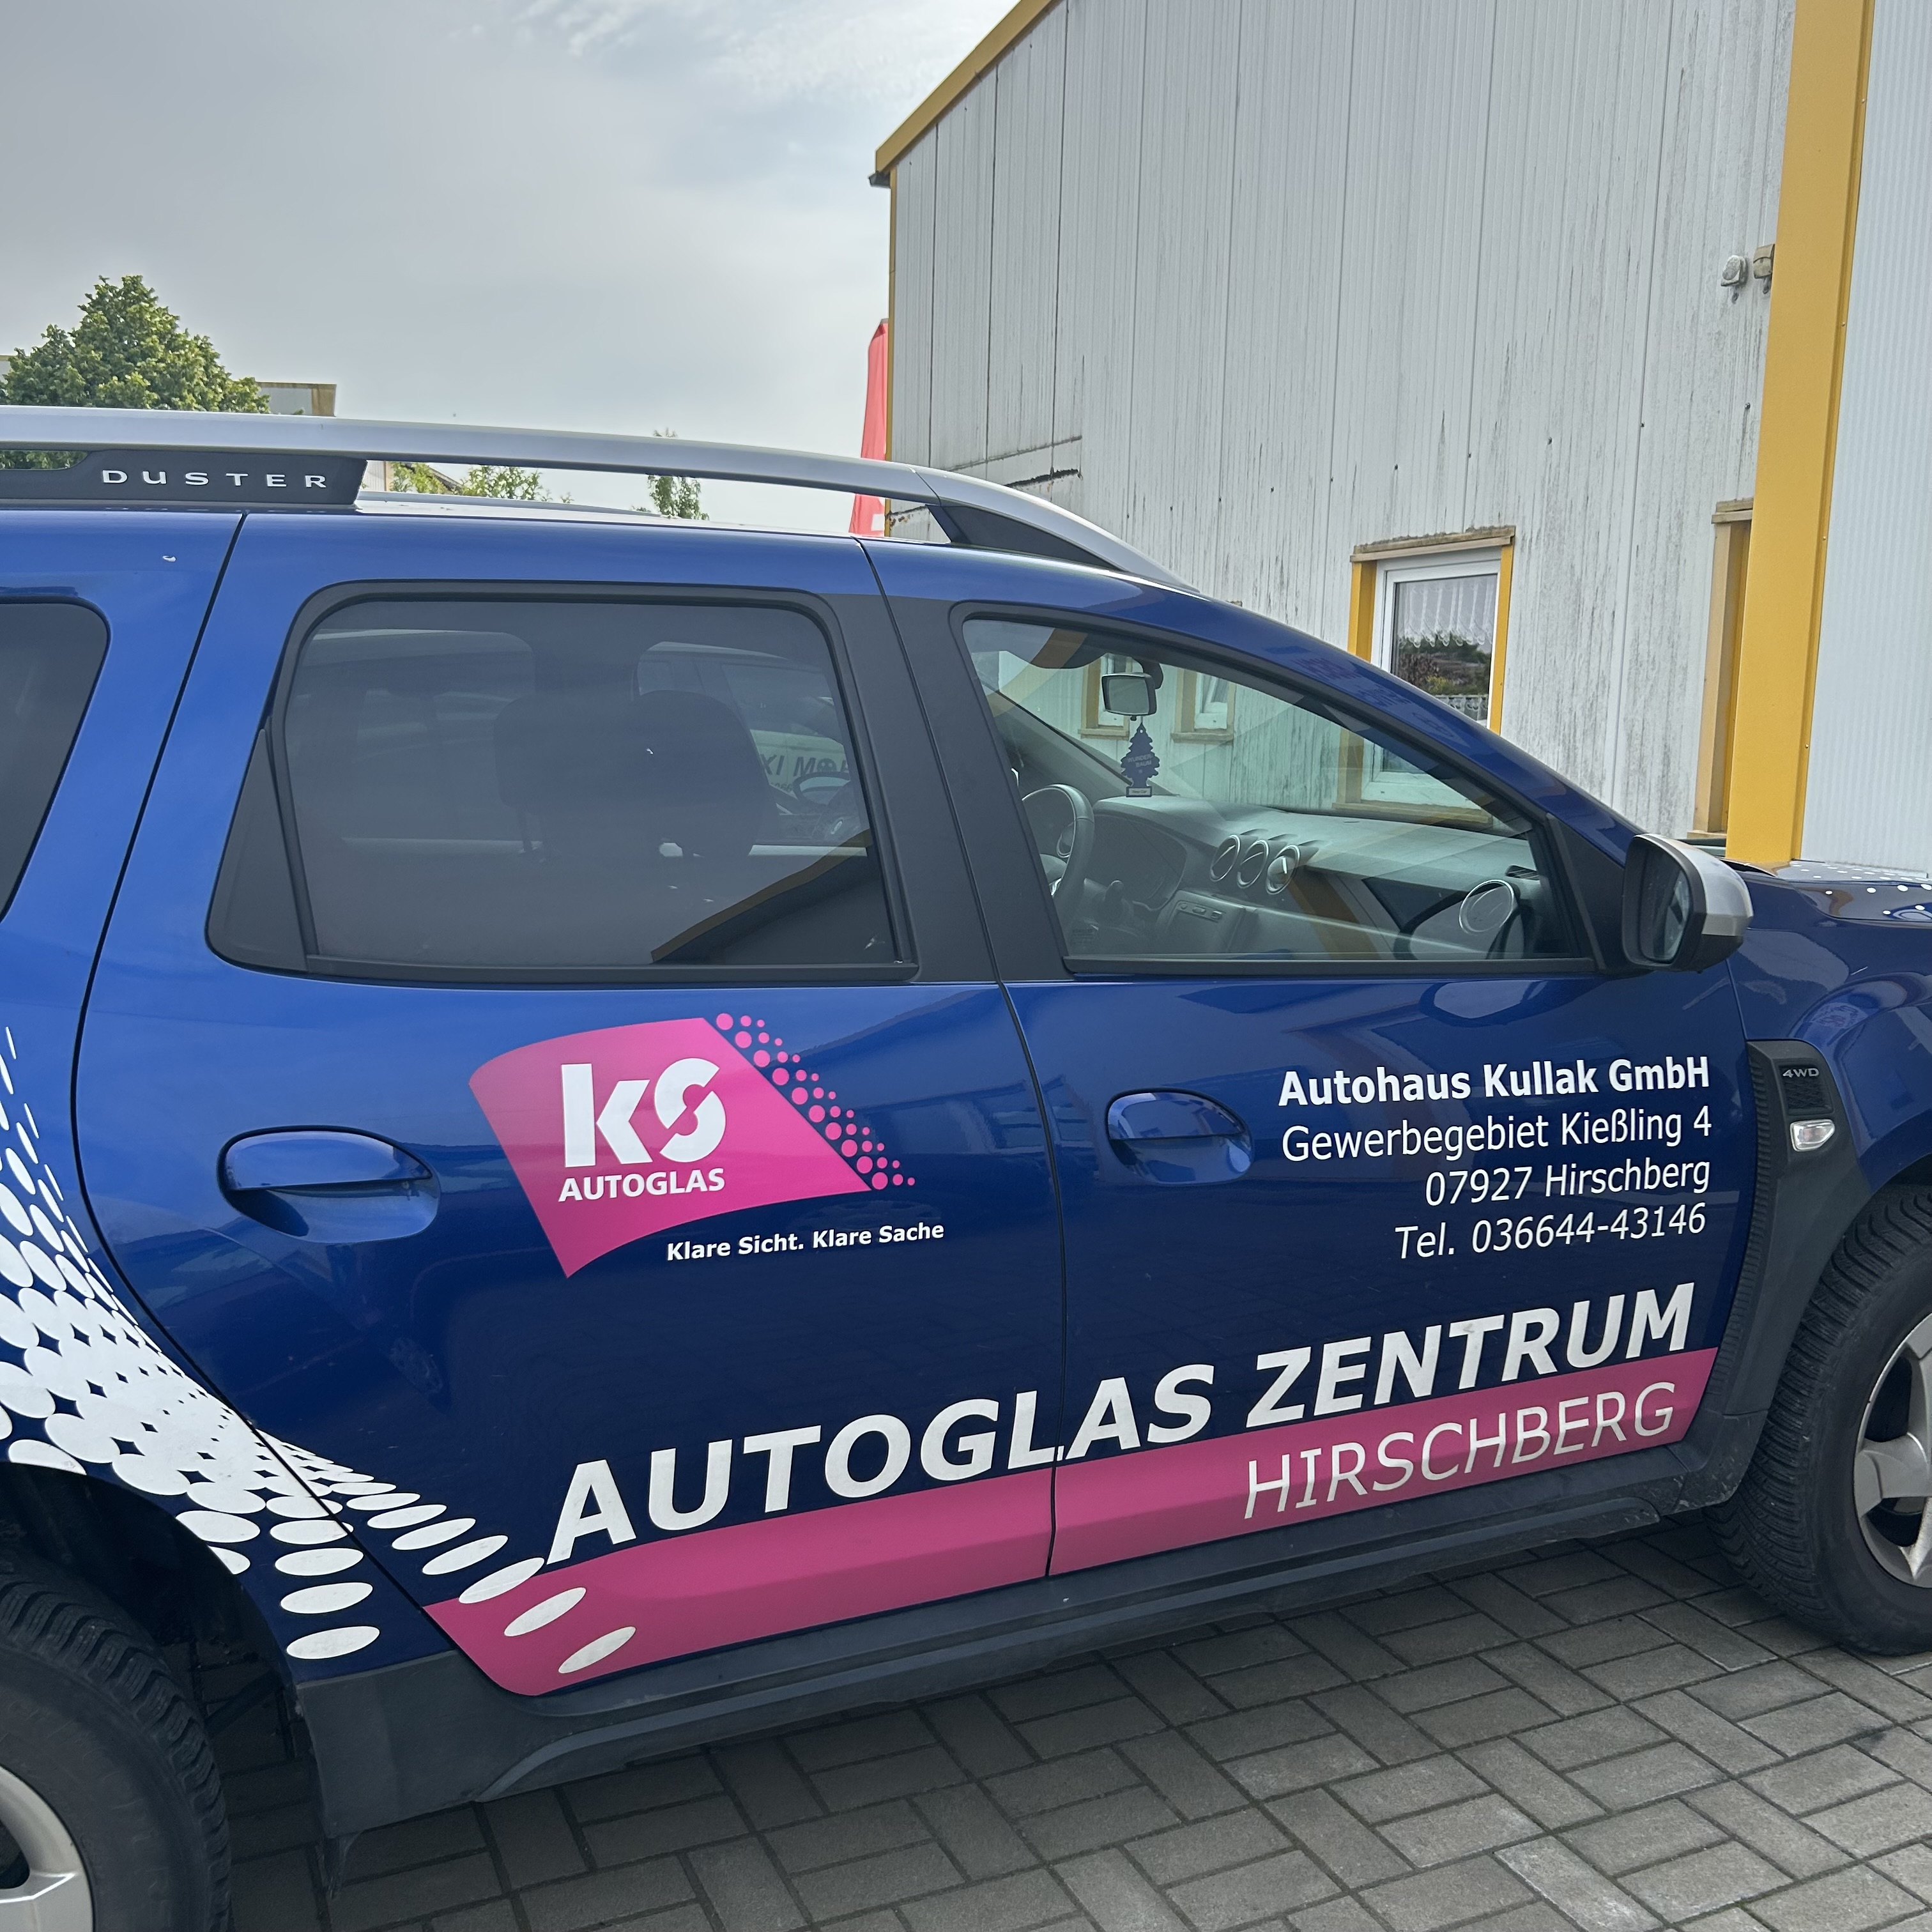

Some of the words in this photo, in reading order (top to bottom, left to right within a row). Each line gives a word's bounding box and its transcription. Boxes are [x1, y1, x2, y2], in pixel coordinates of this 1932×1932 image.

[102, 470, 326, 488] DUSTER
[1278, 1066, 1471, 1107] Autohaus
[1483, 1059, 1599, 1098] Kullak
[1609, 1056, 1709, 1092] GmbH
[1782, 1068, 1820, 1078] 4WD
[1282, 1115, 1549, 1162] Gewerbegebiet
[1562, 1108, 1682, 1147] Kießling
[1693, 1105, 1712, 1137] 4
[558, 1168, 725, 1202] AUTOGLAS
[1426, 1166, 1533, 1206] 07927
[1545, 1157, 1710, 1197] Hirschberg
[667, 1241, 731, 1261] Klare
[739, 1233, 804, 1255] Sicht.
[813, 1229, 871, 1248] Klare
[878, 1222, 944, 1243] Sache
[1395, 1222, 1454, 1259] Tel.
[1472, 1202, 1706, 1253] 036644-43146
[551, 1364, 1215, 1563] AUTOGLAS
[1246, 1282, 1694, 1428] ZENTRUM
[1244, 1382, 1675, 1519] HIRSCHBERG
